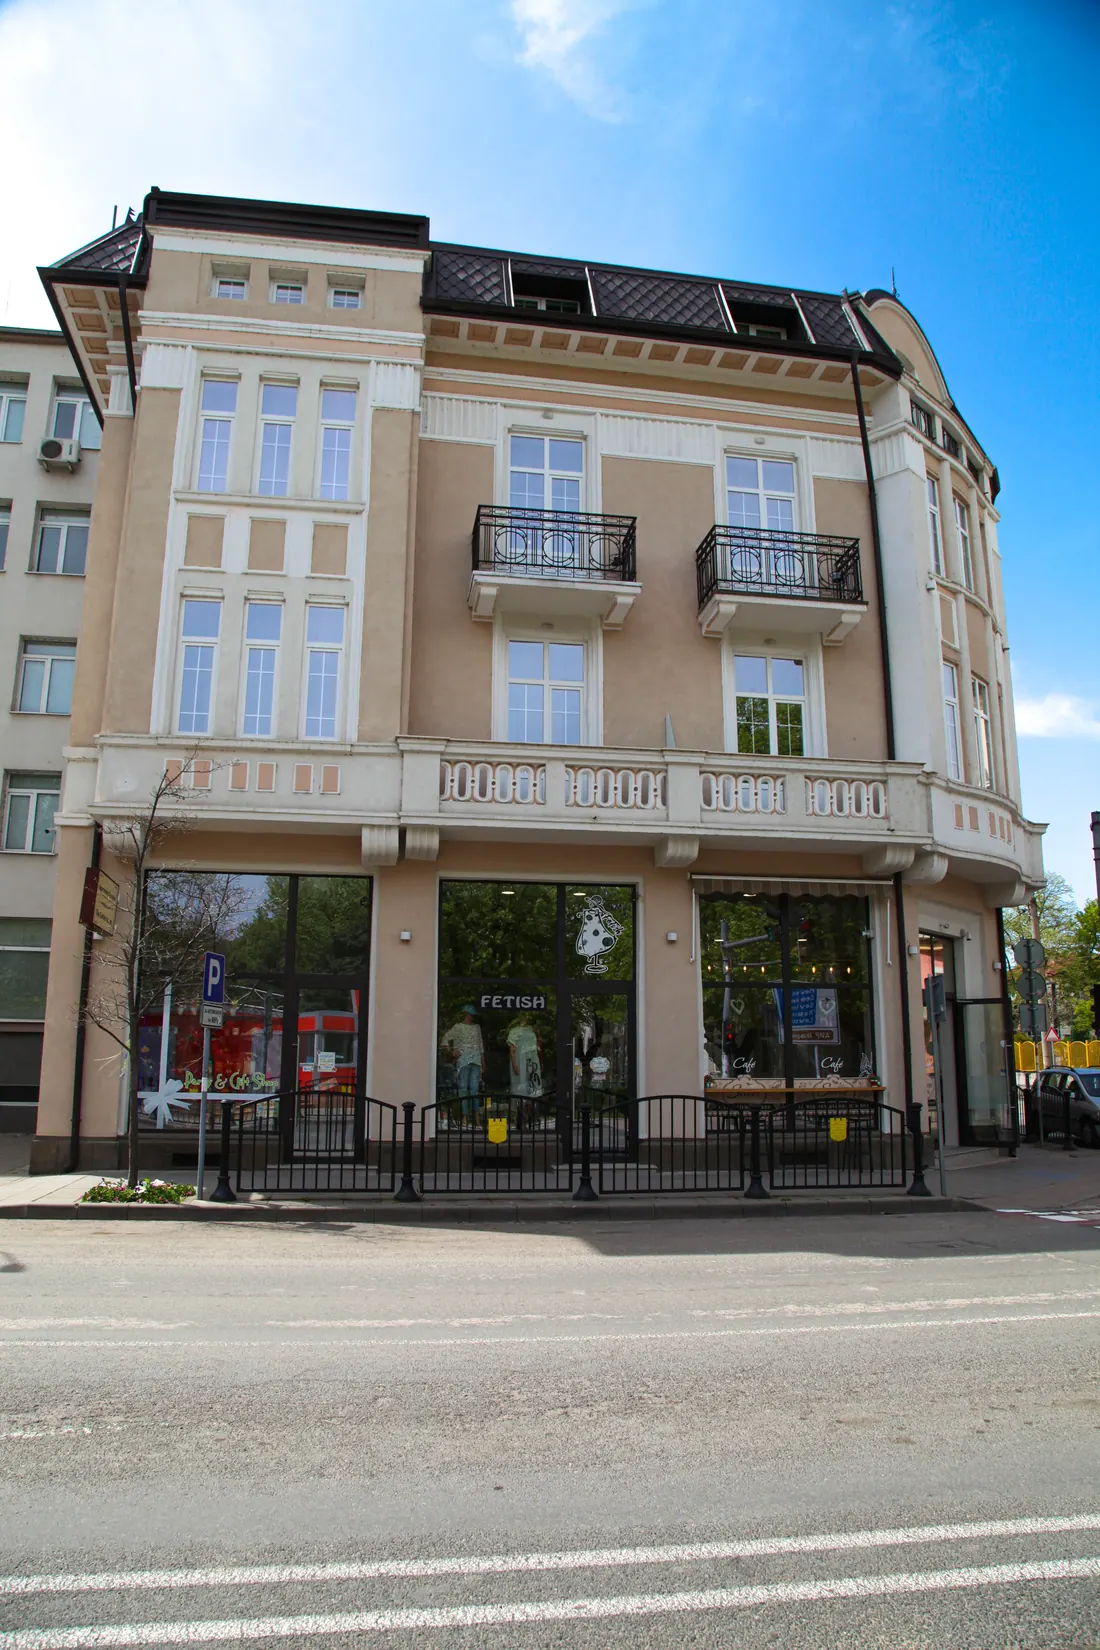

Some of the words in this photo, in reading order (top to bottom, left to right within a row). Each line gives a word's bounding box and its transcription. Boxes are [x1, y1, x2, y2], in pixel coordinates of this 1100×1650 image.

[207, 958, 220, 997] P
[481, 995, 545, 1009] FETISH
[733, 1056, 757, 1073] Café
[821, 1056, 844, 1072] Café
[184, 1070, 212, 1089] Pary
[214, 1073, 227, 1090] &
[229, 1071, 250, 1090] Gift
[252, 1071, 279, 1093] Shop
